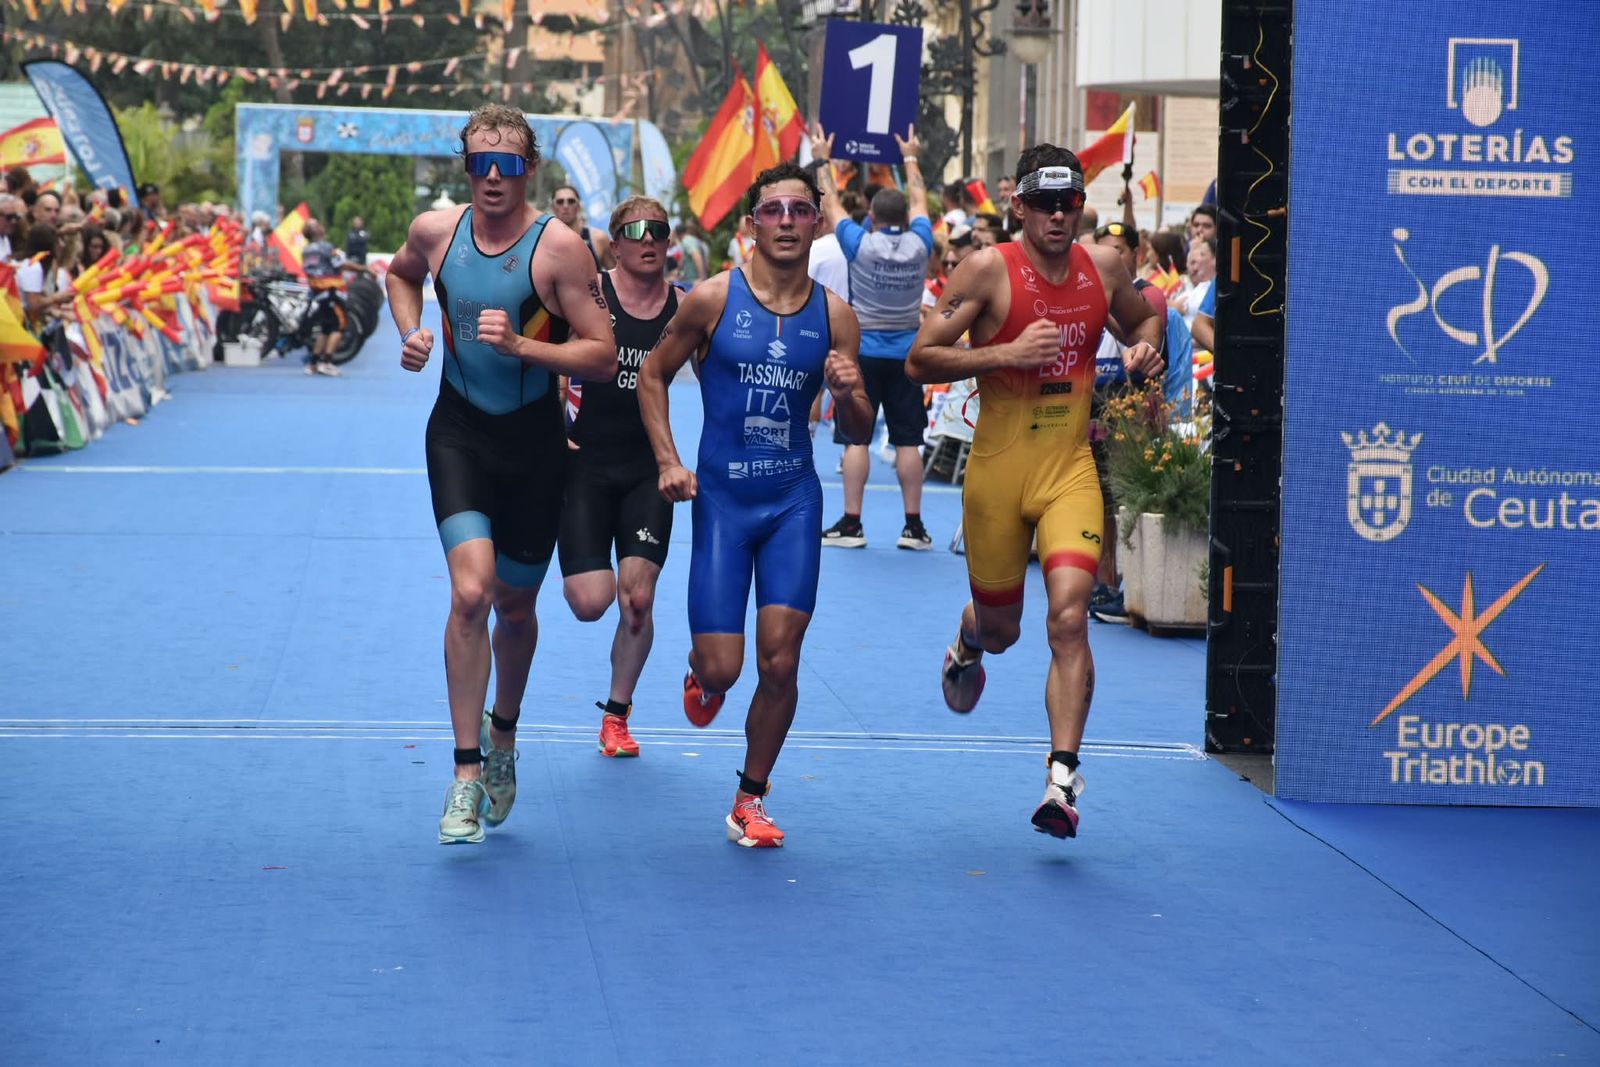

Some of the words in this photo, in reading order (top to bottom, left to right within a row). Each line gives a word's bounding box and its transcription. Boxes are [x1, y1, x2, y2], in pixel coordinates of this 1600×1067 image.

[848, 34, 898, 135] 1
[1387, 129, 1574, 163] LOTERÍAS
[1408, 175, 1441, 190] CON
[1450, 176, 1469, 190] EL
[1474, 176, 1553, 192] DEPORTE
[1058, 322, 1086, 348] MOS
[617, 370, 638, 390] GB
[738, 362, 809, 391] TASSINARI
[745, 388, 791, 416] ITA
[1427, 466, 1496, 484] Ciudad
[1503, 467, 1600, 485] Autónoma
[1426, 488, 1452, 507] de
[1464, 488, 1600, 530] Ceuta
[1398, 715, 1531, 754] Europe
[1383, 751, 1545, 785] Triathlon
